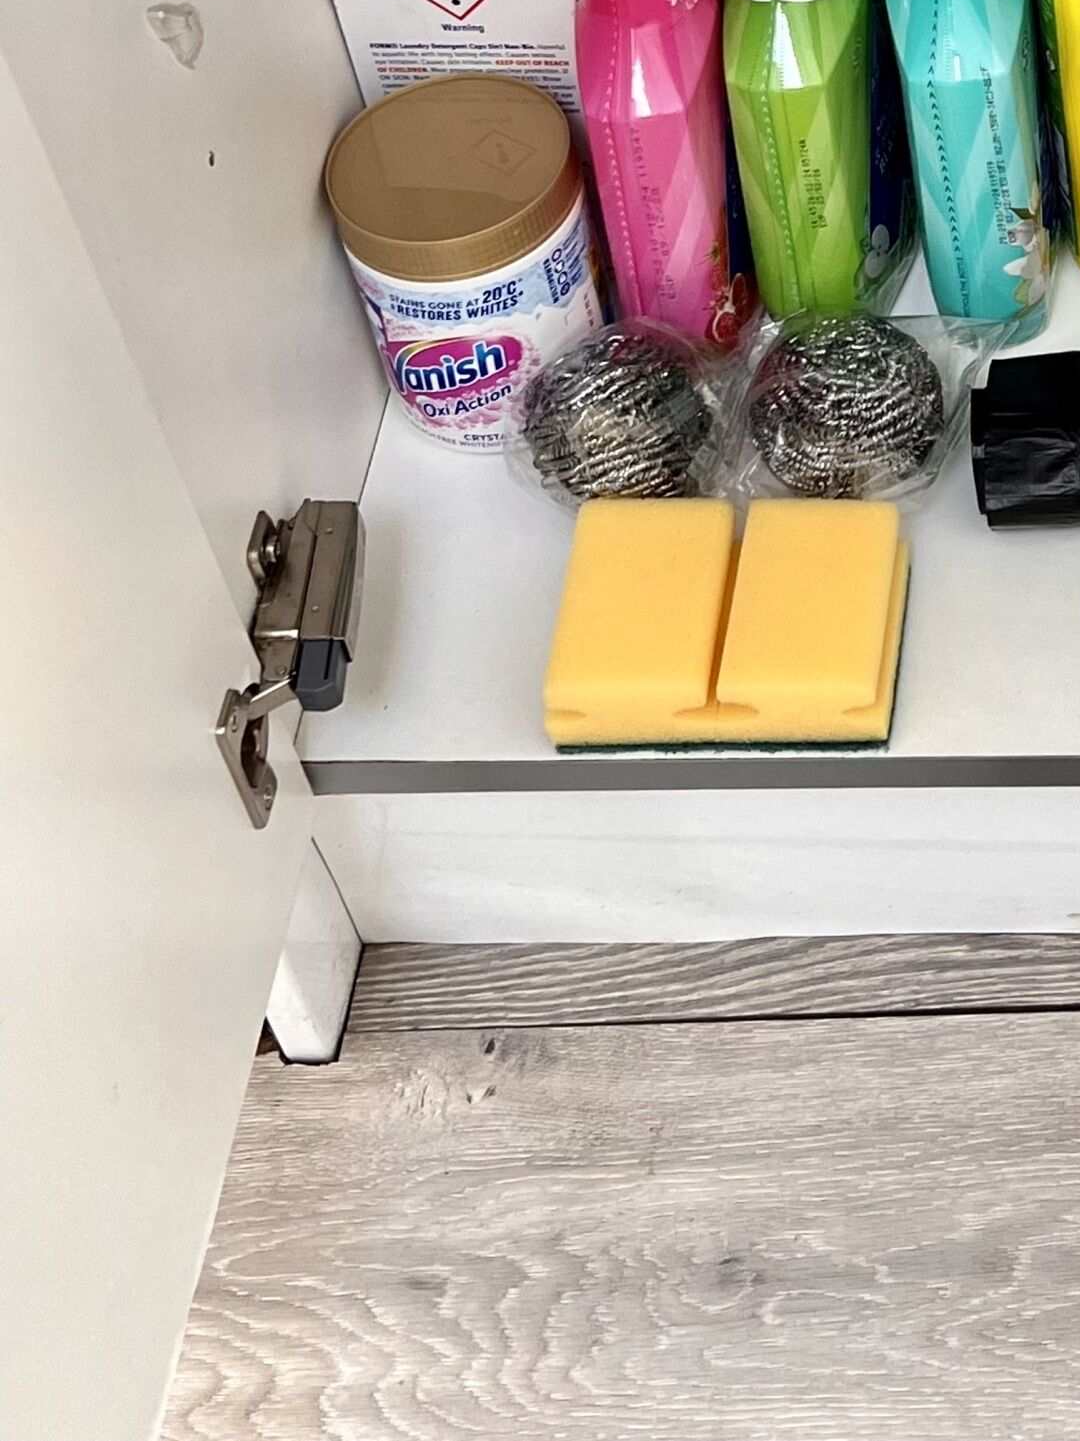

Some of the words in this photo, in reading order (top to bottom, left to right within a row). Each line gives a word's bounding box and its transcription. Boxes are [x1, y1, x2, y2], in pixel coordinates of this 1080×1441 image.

[441, 23, 485, 34] Warning
[389, 293, 426, 310] STAINS
[427, 299, 463, 310] GONE
[465, 298, 480, 308] AT
[397, 306, 462, 321] RESTORES
[395, 340, 507, 395] Vanish
[422, 402, 450, 419] Oxi
[454, 384, 513, 416] Action
[463, 433, 508, 442] CRYSTA
